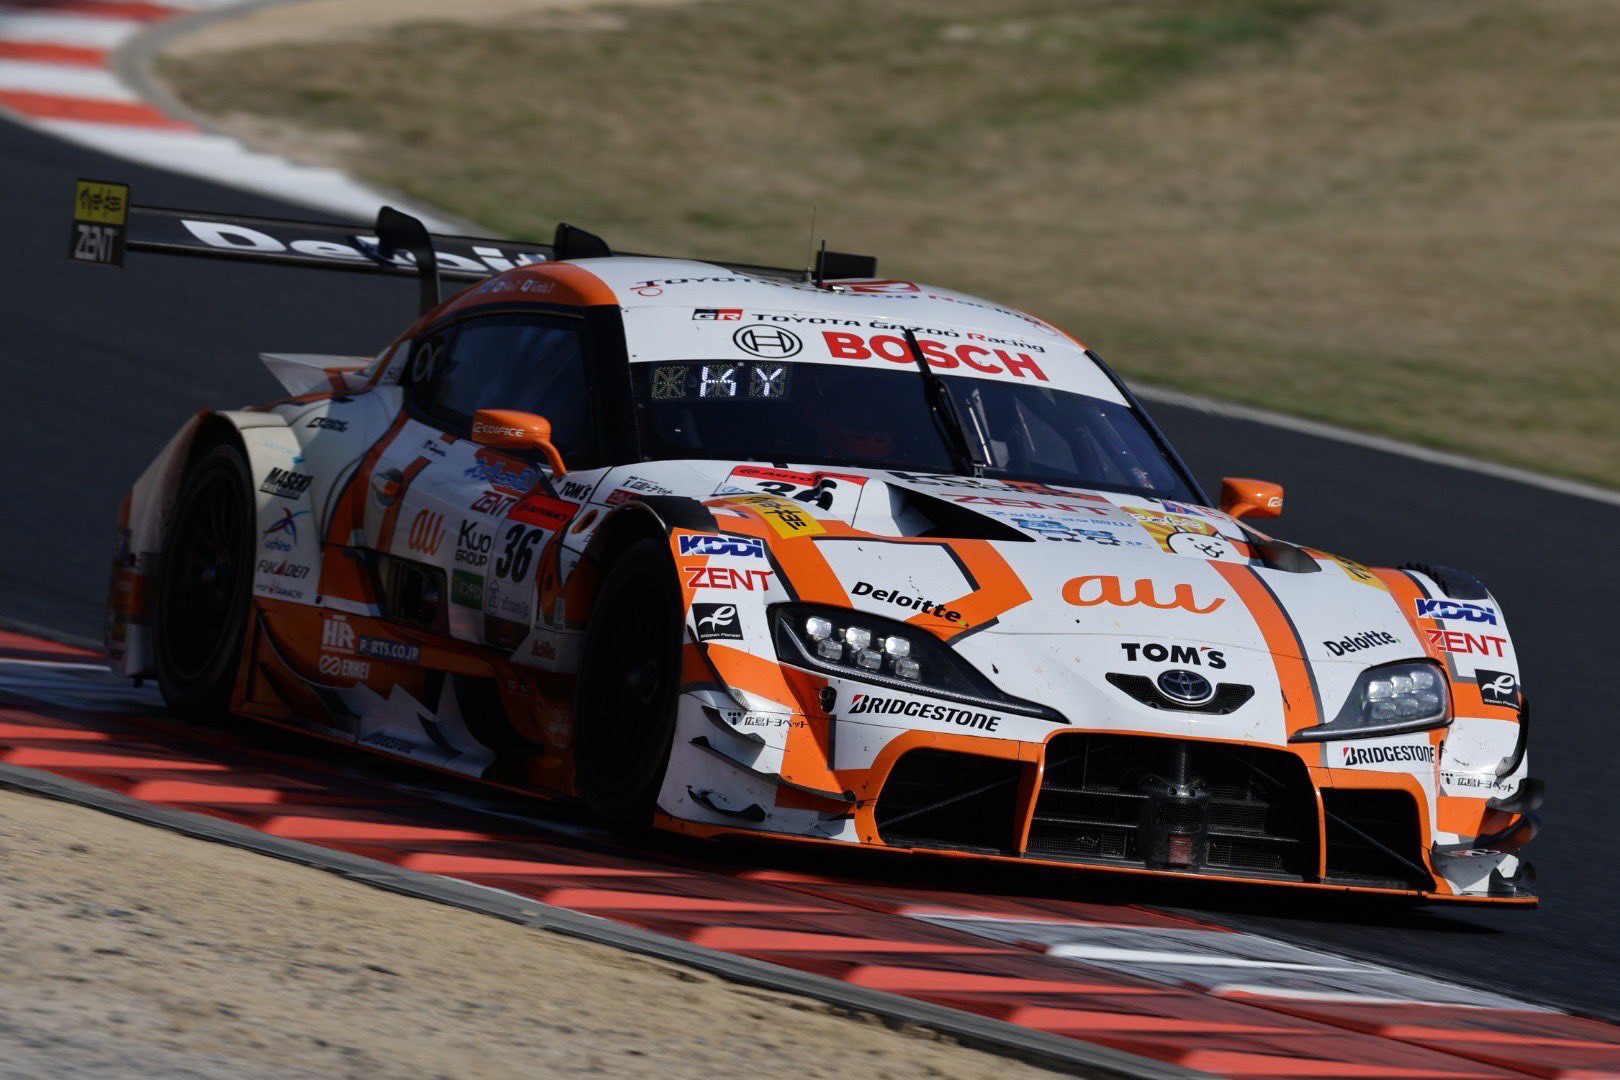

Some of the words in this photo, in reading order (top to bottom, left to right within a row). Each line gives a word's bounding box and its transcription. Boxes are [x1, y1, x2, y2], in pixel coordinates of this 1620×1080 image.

[74, 224, 119, 263] ZENT
[752, 313, 861, 327] TOYOTA
[868, 321, 960, 338] GAZOO
[966, 332, 1044, 353] Racing
[821, 331, 1050, 382] BOSCH
[470, 490, 518, 517] ZENT
[559, 481, 592, 500] TOM'S
[939, 493, 1109, 517] ZENT
[408, 509, 446, 556] au
[455, 549, 488, 568] GROUP
[496, 523, 543, 583] 36
[679, 535, 764, 558] KDDI
[685, 567, 775, 591] ZENT
[1062, 575, 1226, 614] au
[1415, 598, 1497, 626] KDDI
[1121, 643, 1227, 669] TOM'S
[1425, 629, 1507, 658] ZENT
[744, 716, 809, 729] 広島トヨペット
[848, 694, 1002, 732] BRIDGESTONE
[1343, 745, 1435, 766] BRIDGESTONE
